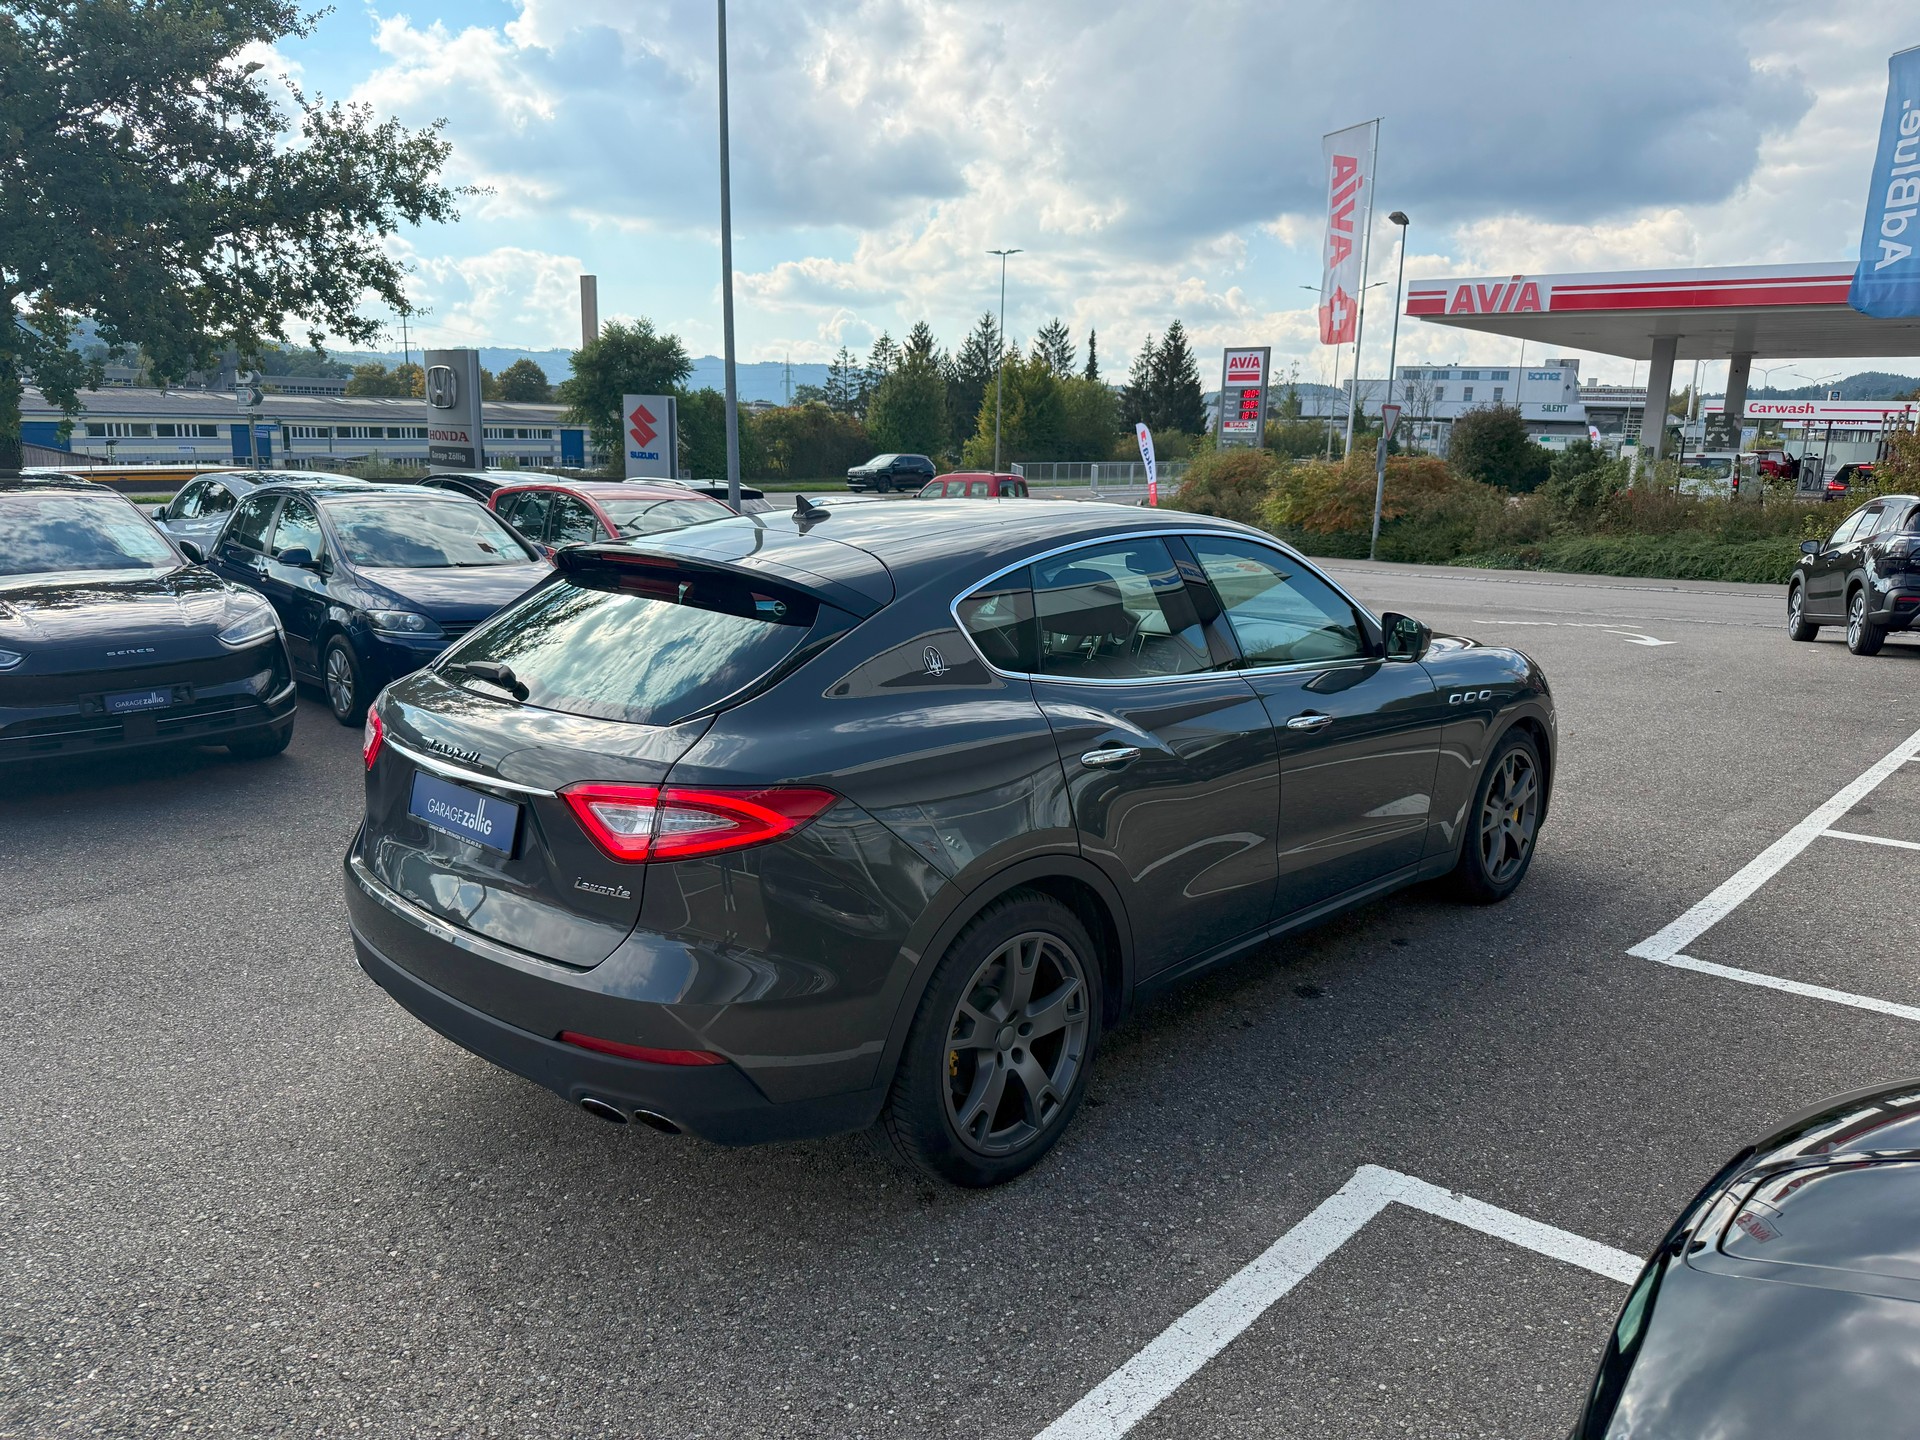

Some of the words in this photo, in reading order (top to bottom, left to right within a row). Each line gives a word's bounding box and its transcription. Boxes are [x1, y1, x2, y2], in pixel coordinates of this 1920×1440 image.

[1449, 274, 1542, 314] AVIA
[1229, 353, 1261, 369] AVIA
[1541, 404, 1568, 413] SILENT
[1749, 402, 1815, 414] Carwash
[429, 430, 470, 442] HONDA
[431, 450, 448, 460] Garage
[448, 452, 466, 463] Zöllig
[630, 451, 659, 461] SUZUKI
[573, 876, 631, 899] Levante
